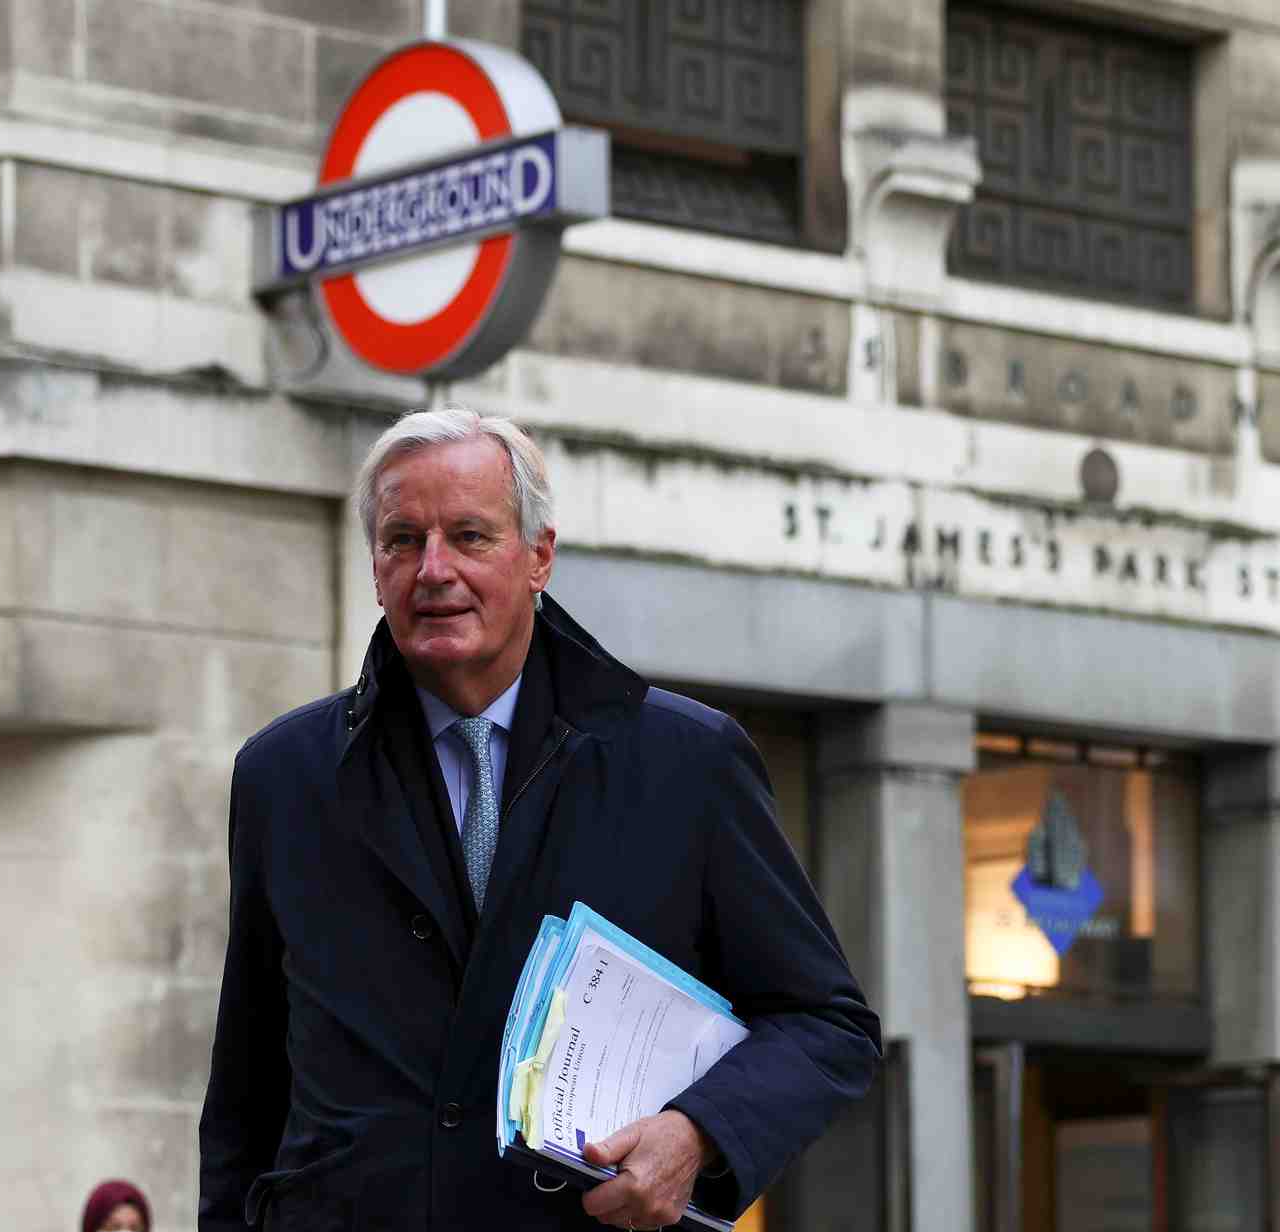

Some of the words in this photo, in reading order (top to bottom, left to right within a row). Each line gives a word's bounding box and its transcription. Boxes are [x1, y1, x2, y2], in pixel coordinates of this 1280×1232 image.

[285, 143, 555, 272] UNDERGROUND
[1093, 544, 1208, 592] PARK
[582, 992, 593, 1005] C
[588, 967, 604, 991] 384
[557, 1025, 581, 1084] Journal
[552, 1085, 566, 1141] Official
